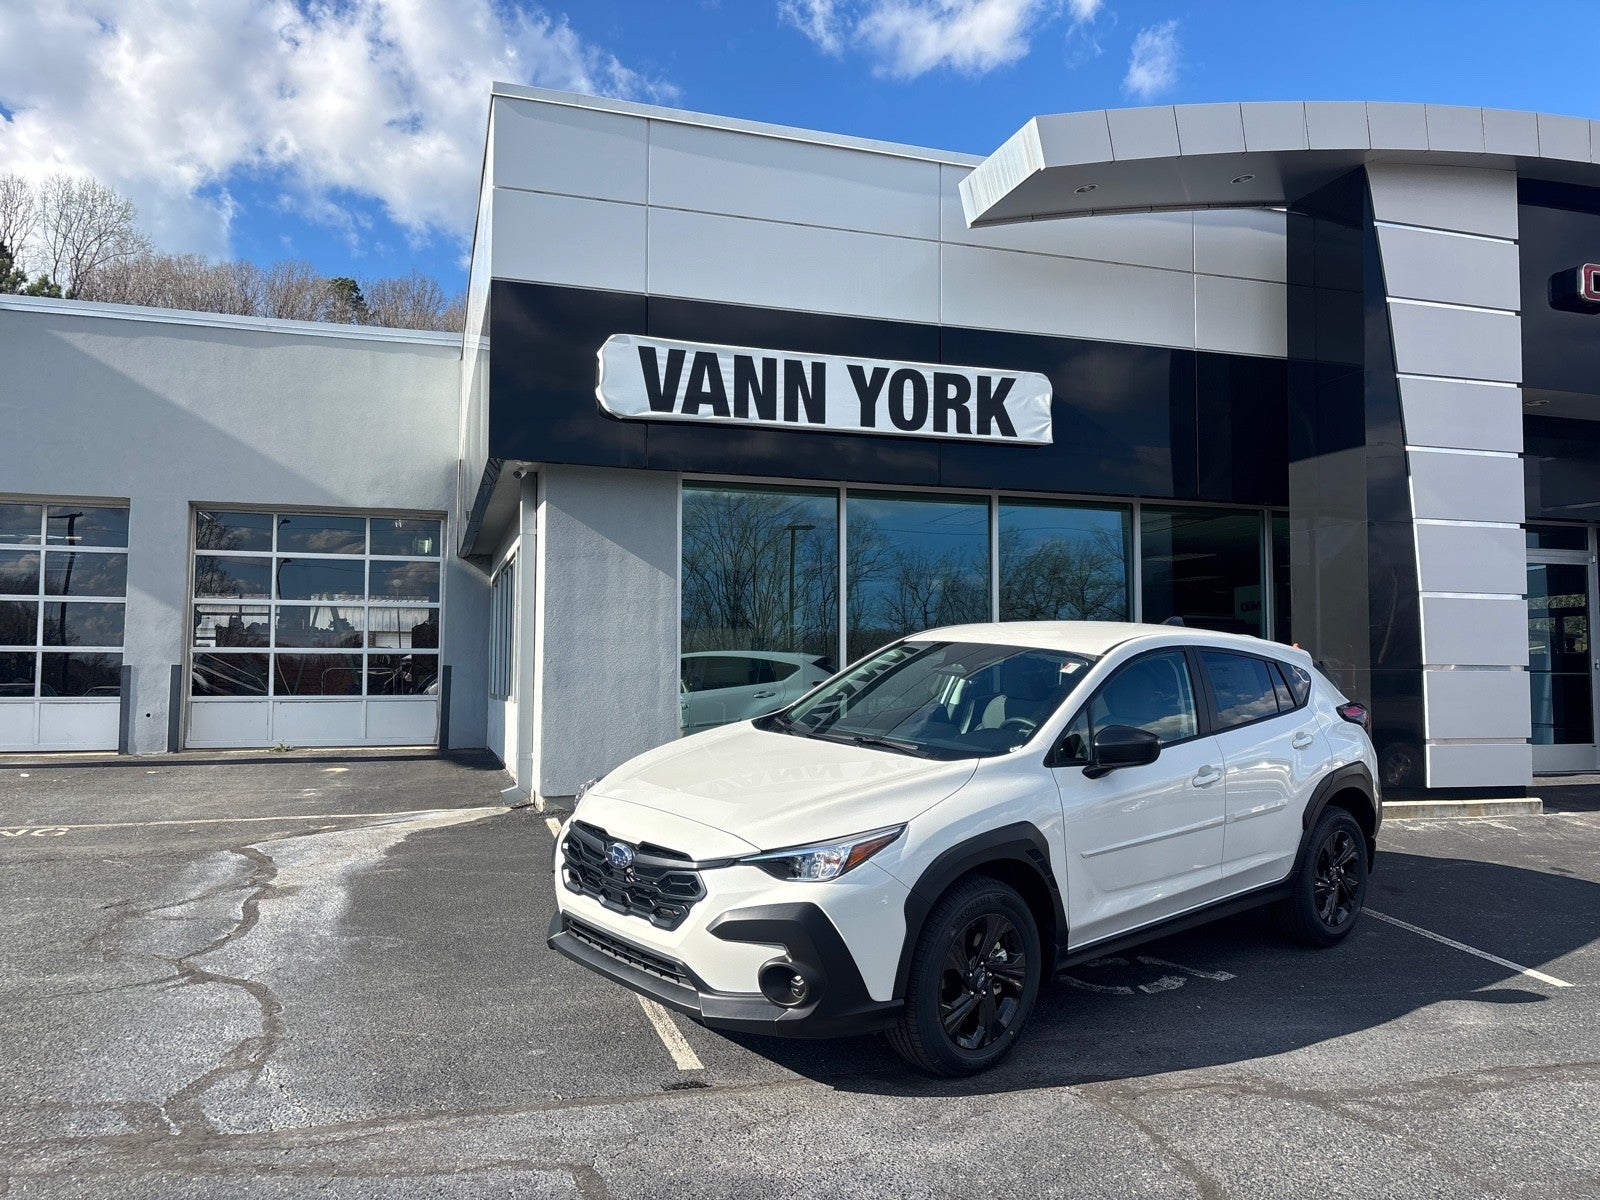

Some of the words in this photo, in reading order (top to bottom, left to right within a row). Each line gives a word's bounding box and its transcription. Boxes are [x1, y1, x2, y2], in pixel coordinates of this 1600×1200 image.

[637, 345, 827, 425] VANN
[846, 364, 1018, 438] YORK
[951, 896, 992, 929] YOKOHAMA
